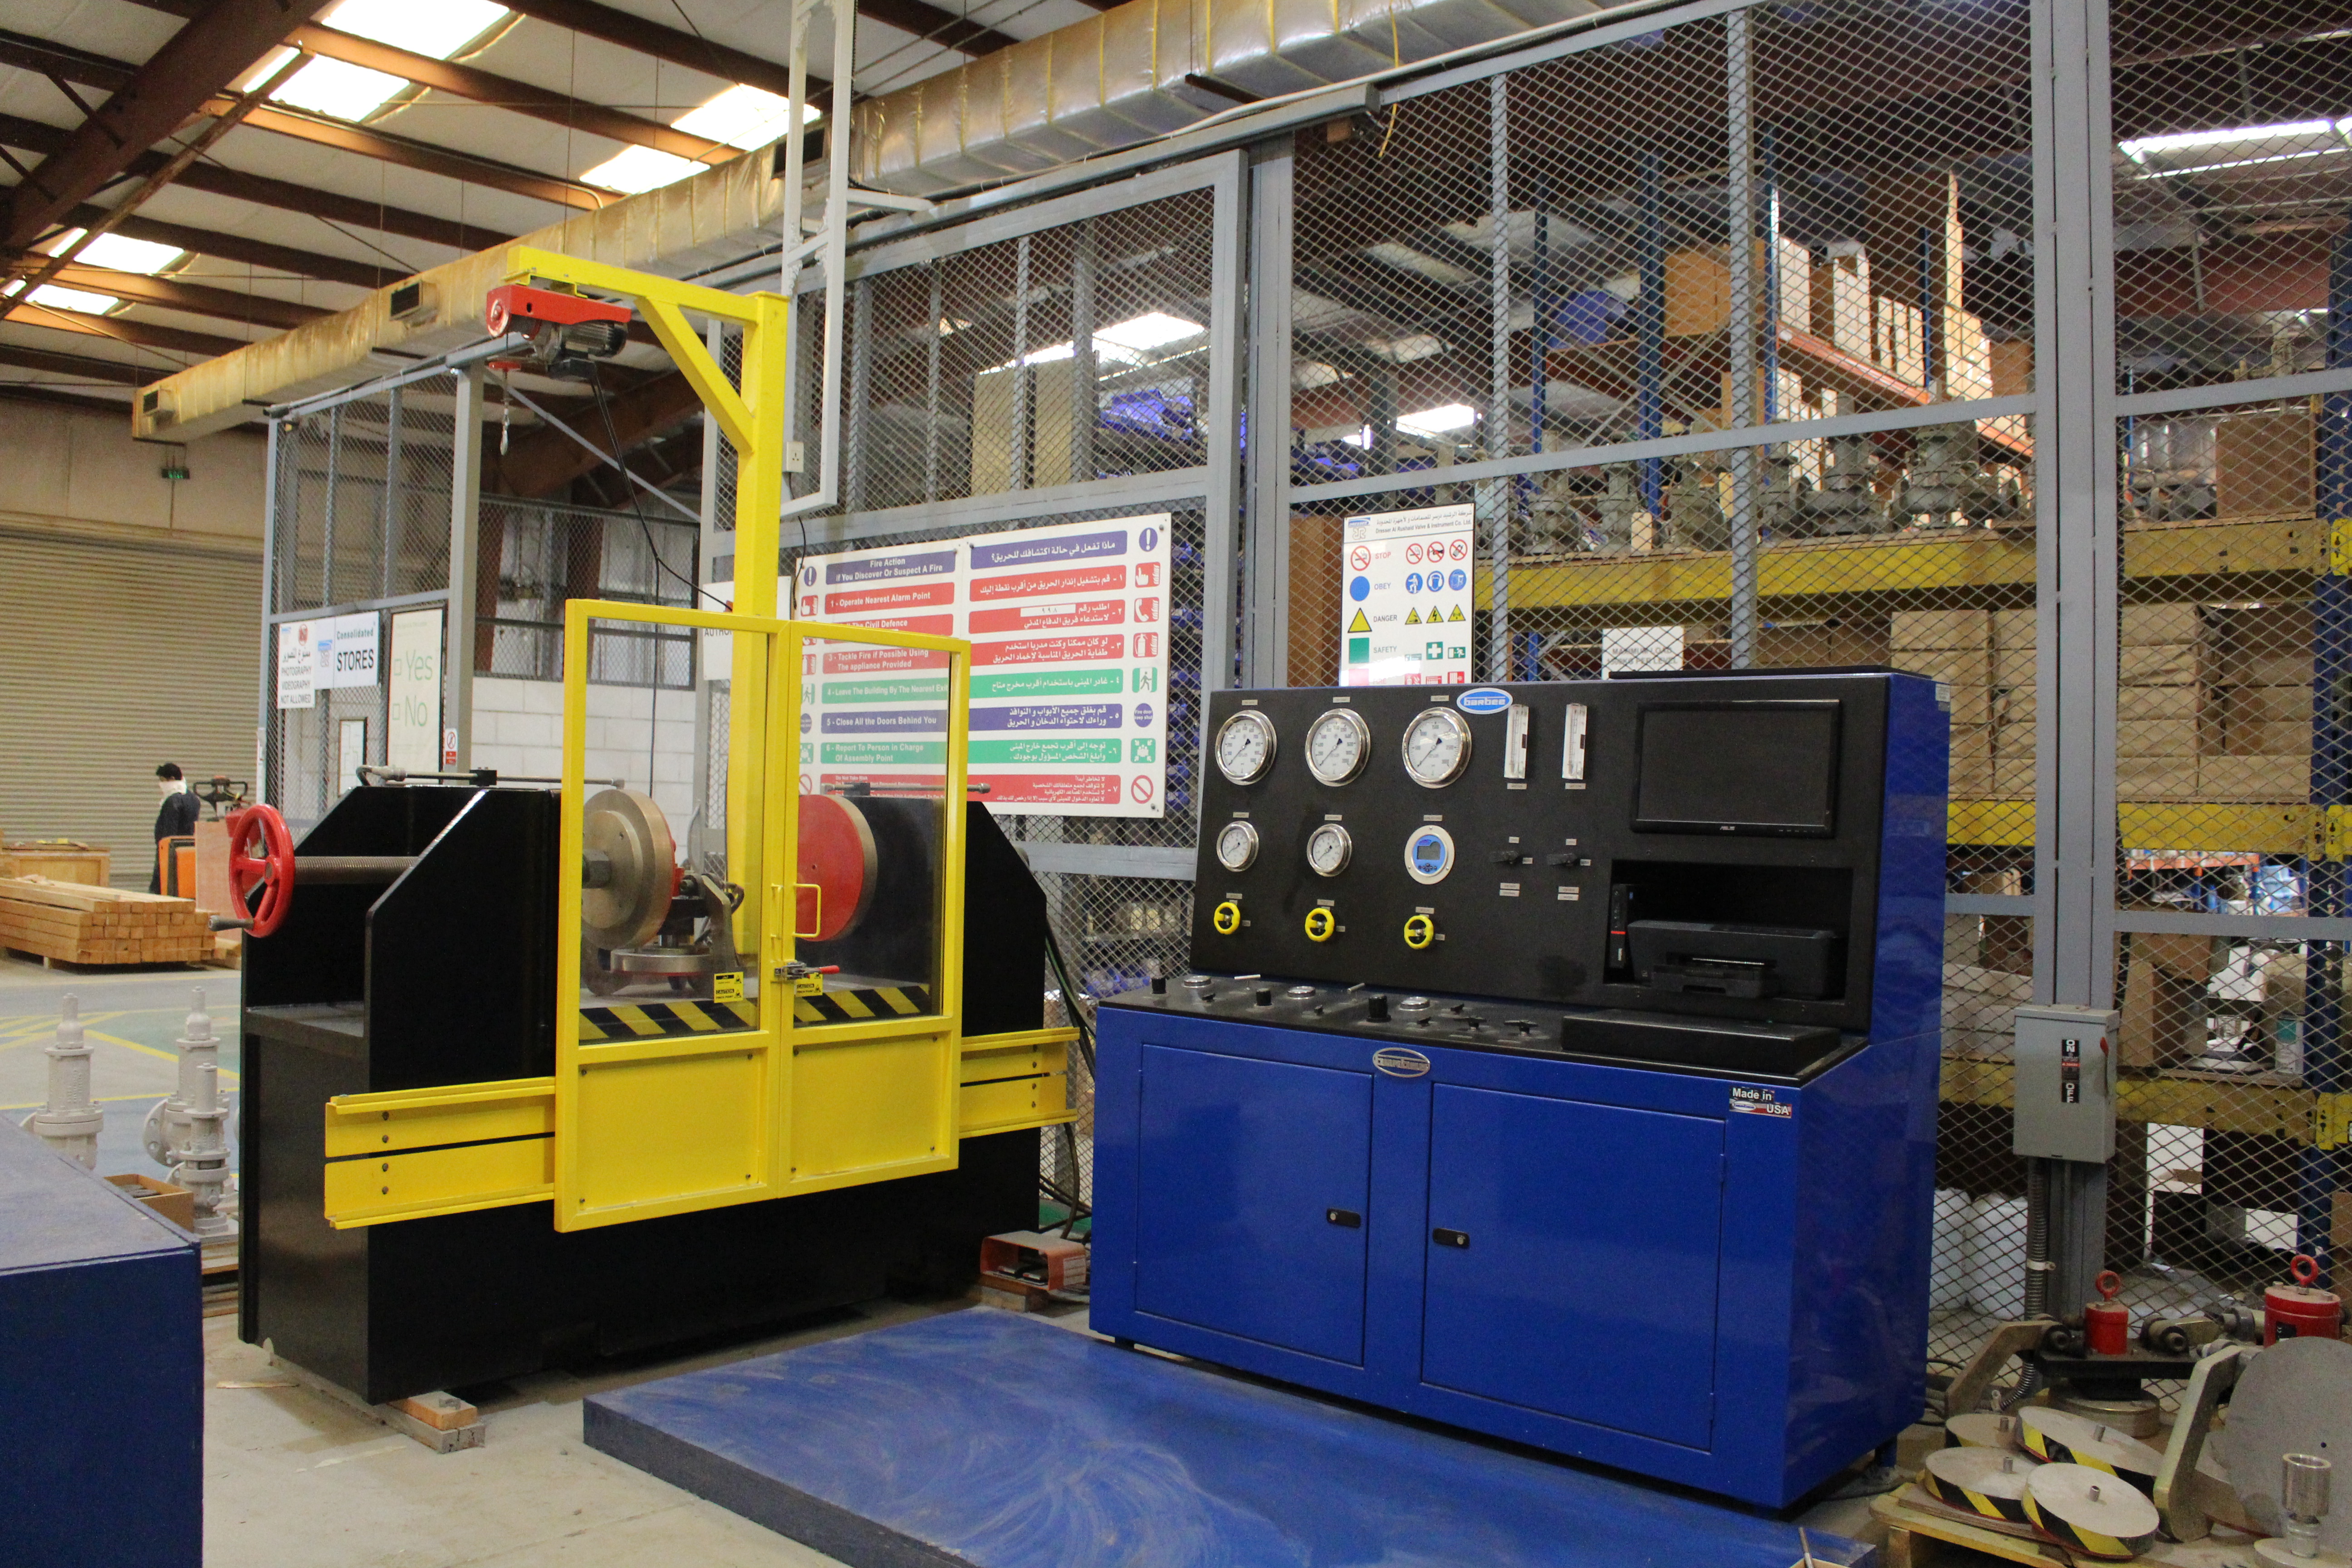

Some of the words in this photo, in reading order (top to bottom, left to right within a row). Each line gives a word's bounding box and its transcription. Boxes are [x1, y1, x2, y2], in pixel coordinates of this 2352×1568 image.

[1081, 542, 1100, 553] تفعل
[1102, 541, 1116, 549] ماذا
[1020, 548, 1050, 558] اكتشافك
[1069, 547, 1080, 556] في
[884, 558, 905, 567] Action
[842, 573, 853, 581] You
[855, 570, 883, 580] Discover
[885, 568, 892, 577] Or
[894, 566, 921, 577] Suspect
[929, 564, 943, 573] Fire
[1037, 579, 1060, 591] الحريق
[1062, 578, 1076, 588] إنذار
[1078, 576, 1101, 587] بتشغيل
[1101, 574, 1111, 586] قم
[980, 585, 994, 596] إليك
[995, 584, 1010, 593] نقطة
[1011, 580, 1026, 593] أقرب
[1026, 583, 1036, 591] من
[839, 597, 864, 608] Operate
[865, 595, 889, 604] Nearest
[891, 593, 911, 603] Alarm
[912, 592, 931, 600] Point
[1078, 604, 1091, 614] رقم
[1093, 603, 1110, 612] اطلب
[1042, 617, 1062, 628] الدفاع
[1062, 615, 1078, 626] فريق
[1080, 613, 1109, 622] لاستدعاء
[881, 620, 908, 628] Defence
[1024, 619, 1042, 630] المدني
[337, 627, 373, 640] Consolidated
[1005, 642, 1029, 652] استخدم
[1030, 642, 1048, 650] مدربا
[1049, 640, 1066, 649] وكنت
[1068, 638, 1086, 647] ممكنا
[1087, 637, 1099, 647] كان
[1101, 637, 1108, 647] لو
[859, 652, 871, 660] Fire
[879, 649, 907, 658] Possible
[909, 648, 929, 657] Using
[1038, 652, 1061, 661] المناسبة
[1062, 650, 1086, 660] الحريق
[1088, 648, 1108, 657] طفاية
[337, 649, 374, 671] STORES
[993, 653, 1015, 664] الحريق
[406, 649, 432, 681] Yes
[850, 662, 880, 671] appliance
[882, 660, 911, 668] Provided
[281, 666, 312, 676] PHOTOGRAPHY
[1026, 677, 1042, 690] أقرب
[1043, 679, 1073, 688] باستخدام
[1074, 678, 1093, 687] المبنى
[1093, 677, 1108, 686] غادر
[853, 687, 863, 695] The
[864, 686, 888, 696] Building
[889, 686, 897, 695] By
[911, 684, 935, 693] Nearest
[936, 684, 948, 692] Exit
[992, 682, 1005, 692] متاح
[1006, 682, 1024, 692] مخرج
[281, 695, 289, 703] NOT
[289, 694, 311, 704] ALLOWED
[405, 695, 427, 726] No
[1009, 708, 1032, 716] النوافذ
[1037, 706, 1060, 715] الأبواب
[1061, 708, 1078, 718] جميع
[1081, 706, 1097, 715] بغلق
[1097, 705, 1107, 715] قم
[877, 717, 896, 725] Doors
[898, 716, 921, 724] Behind
[923, 716, 936, 724] You
[1007, 718, 1030, 728] الحريق
[1036, 718, 1059, 727] الدخان
[1060, 717, 1085, 726] لاحتواء
[1086, 717, 1107, 726] وراءك
[835, 744, 856, 752] Report
[867, 743, 889, 751] Person
[899, 743, 924, 752] Charge
[1009, 743, 1026, 752] المبنى
[1026, 743, 1040, 752] خارج
[1042, 743, 1058, 753] تجمع
[1060, 740, 1077, 751] أقرب
[1078, 742, 1088, 751] إلى
[1089, 742, 1106, 750] توجه
[844, 754, 874, 763] Assembly
[1062, 753, 1089, 761] الشخص
[1090, 752, 1106, 763] وأبلغ
[2066, 1039, 2075, 1052] ON
[1733, 1088, 1759, 1099] Made
[1763, 1091, 1772, 1100] in
[2066, 1083, 2075, 1103] OFF
[1766, 1103, 1789, 1115] USA
